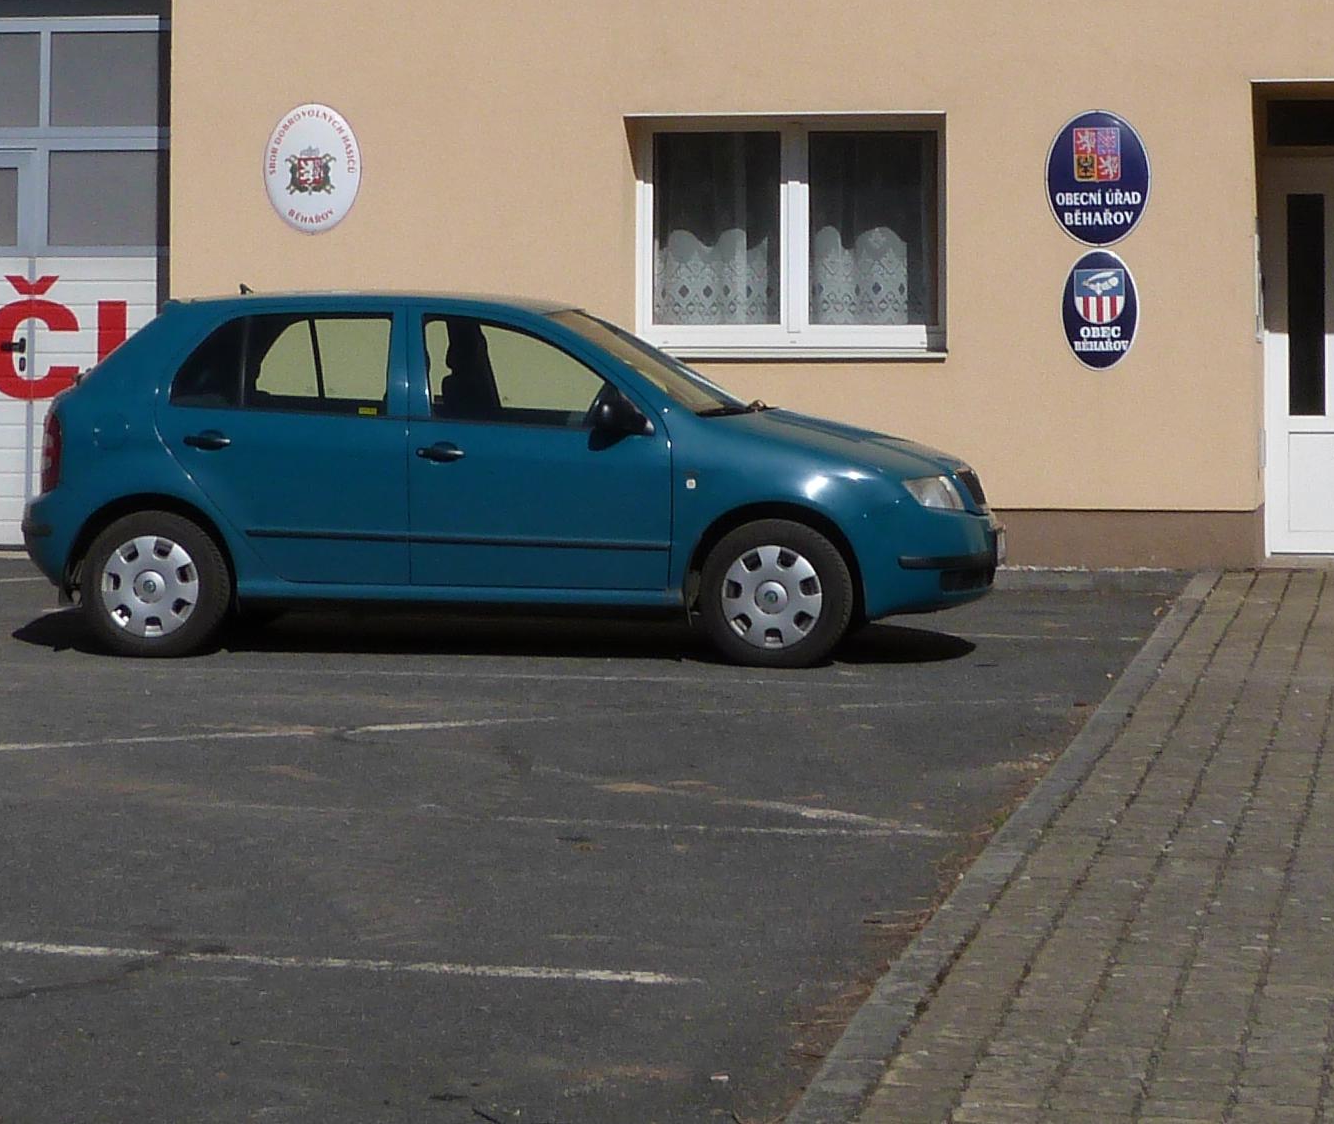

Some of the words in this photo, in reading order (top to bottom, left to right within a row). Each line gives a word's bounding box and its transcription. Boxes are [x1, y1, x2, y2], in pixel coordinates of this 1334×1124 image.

[1055, 188, 1102, 206] OBECNÍ
[1105, 188, 1142, 205] ÚŘAD
[1063, 208, 1134, 226] BĚHAŘOV
[1079, 326, 1122, 338] OBEC
